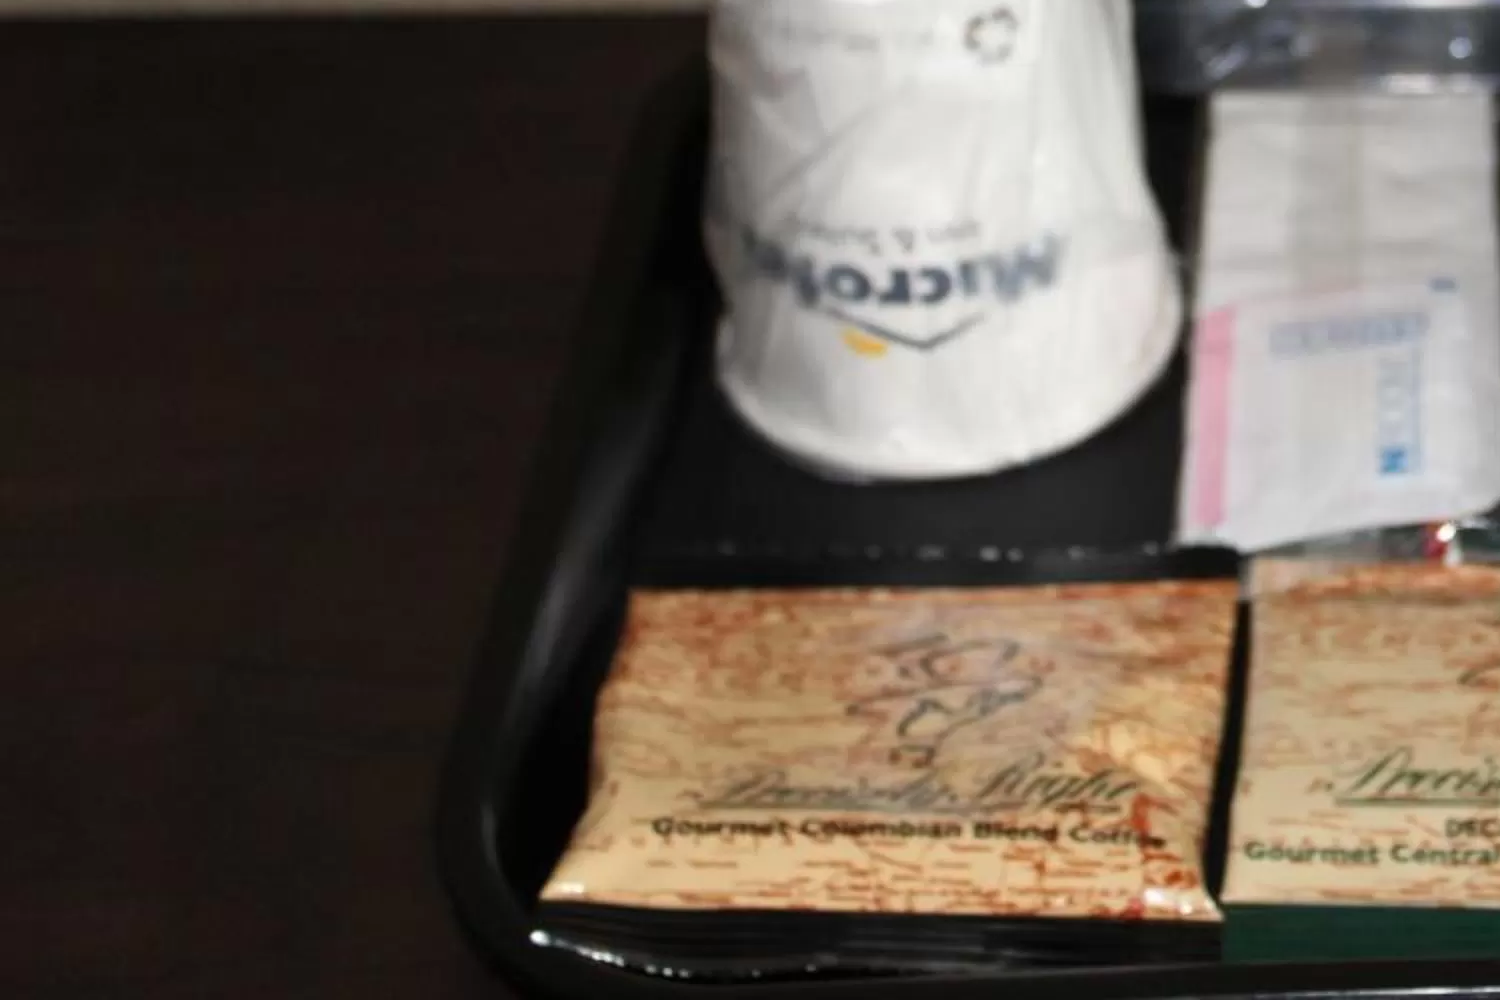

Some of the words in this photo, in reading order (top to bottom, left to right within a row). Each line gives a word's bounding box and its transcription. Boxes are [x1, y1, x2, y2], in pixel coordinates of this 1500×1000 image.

[970, 751, 1139, 812] Right
[652, 817, 791, 838] Gourmet
[974, 819, 1059, 842] Blend
[1243, 841, 1379, 863] Gourmet
